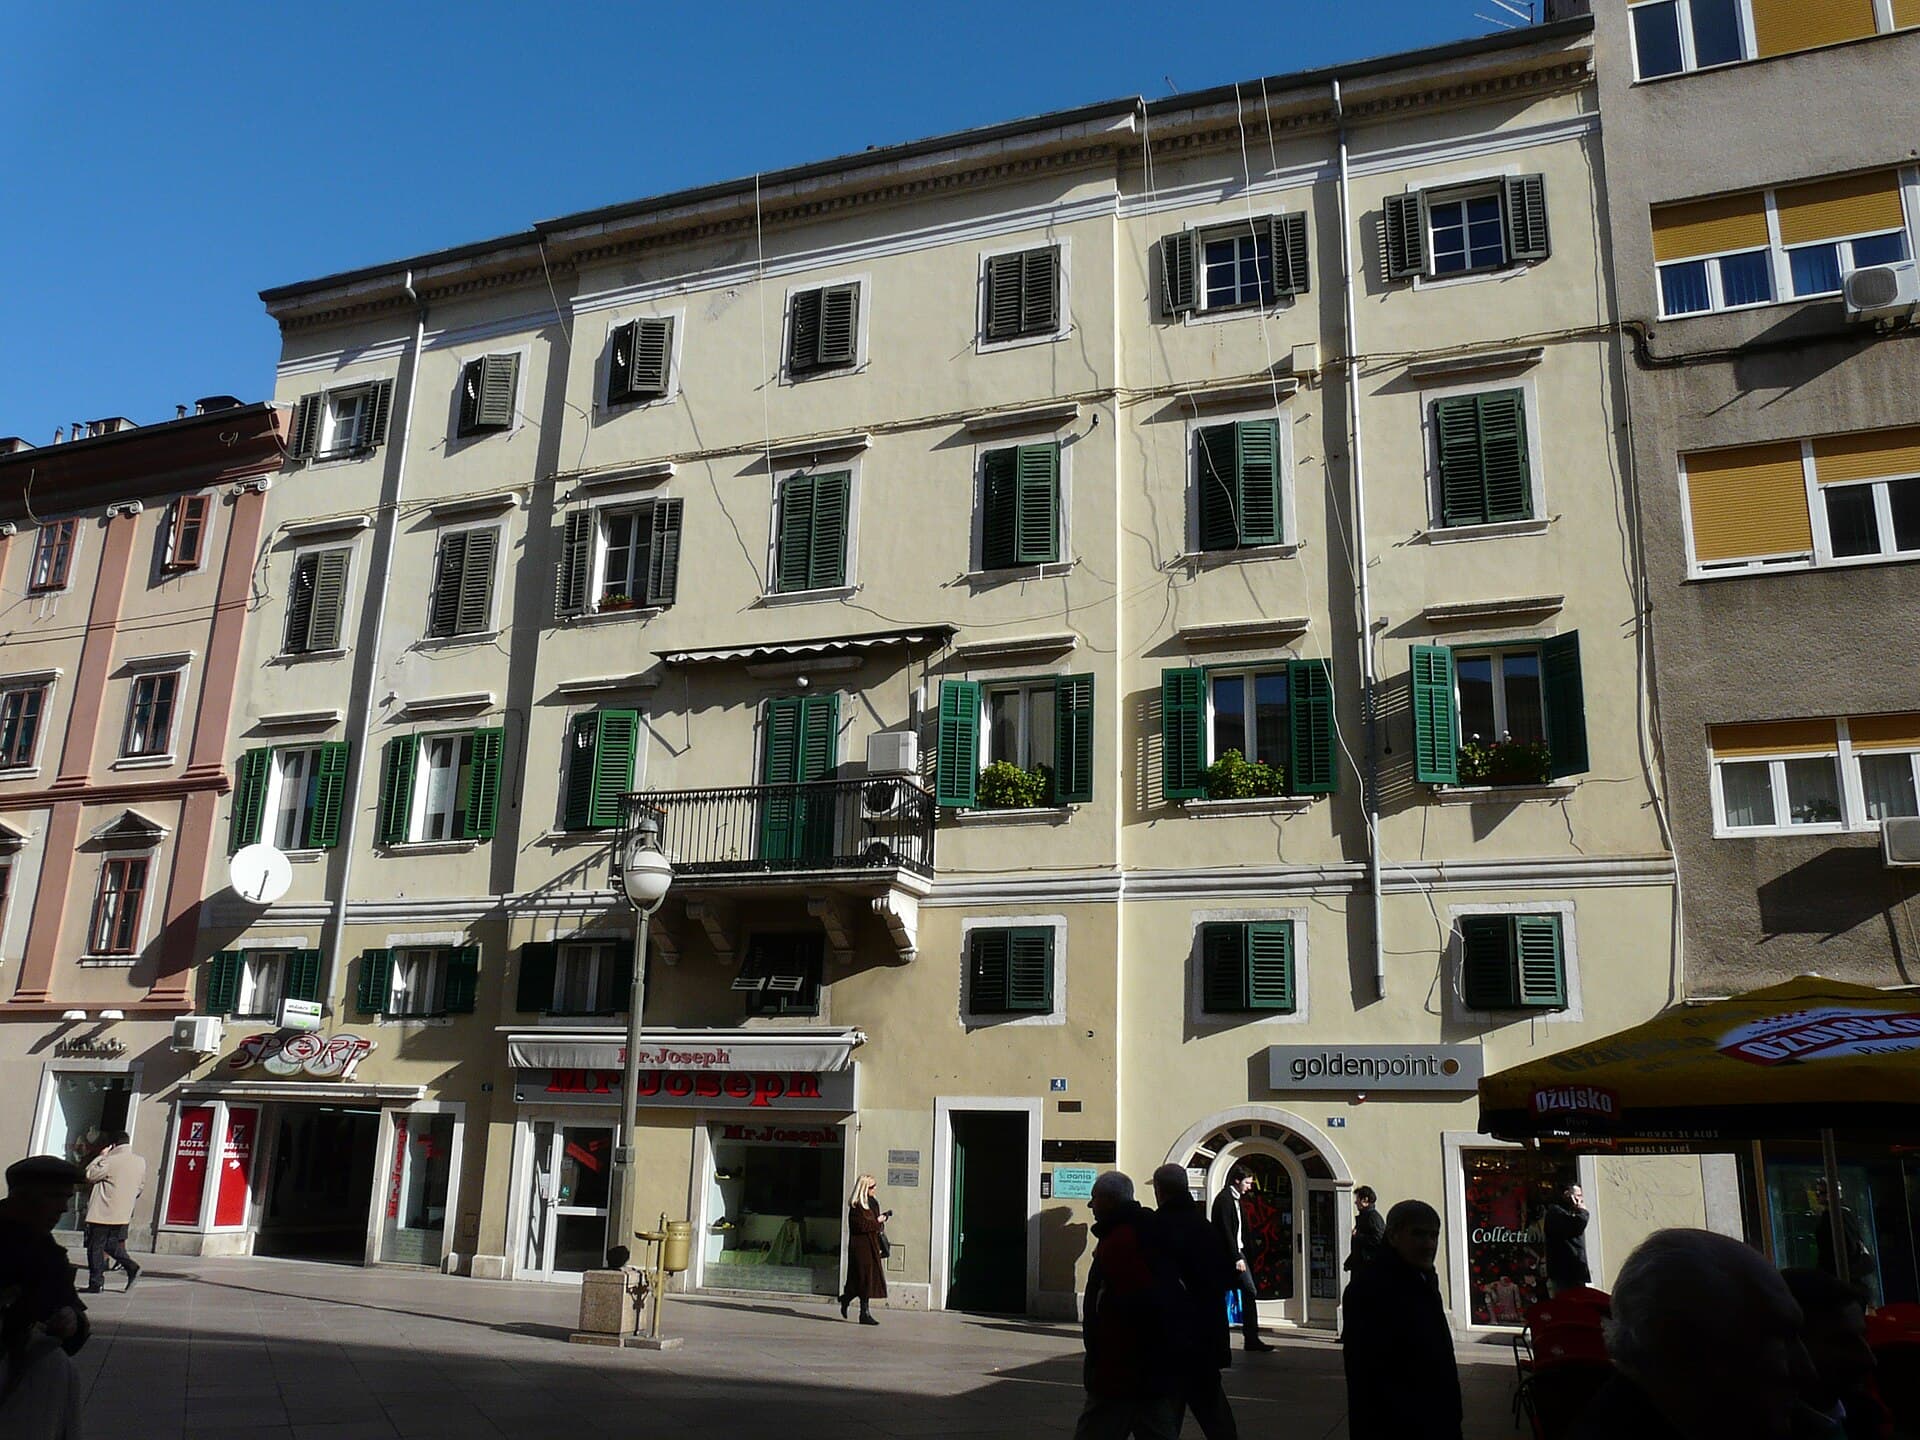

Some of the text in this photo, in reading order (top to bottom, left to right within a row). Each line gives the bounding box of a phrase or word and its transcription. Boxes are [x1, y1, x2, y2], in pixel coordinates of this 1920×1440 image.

[229, 1032, 374, 1078] SPORT
[1739, 1017, 1920, 1061] Ožujsko
[1290, 1052, 1438, 1081] goldenpoint
[545, 1070, 821, 1107] MrJoseph
[1535, 1087, 1613, 1113] Ožujsko
[723, 1125, 838, 1147] Mr.Joseph
